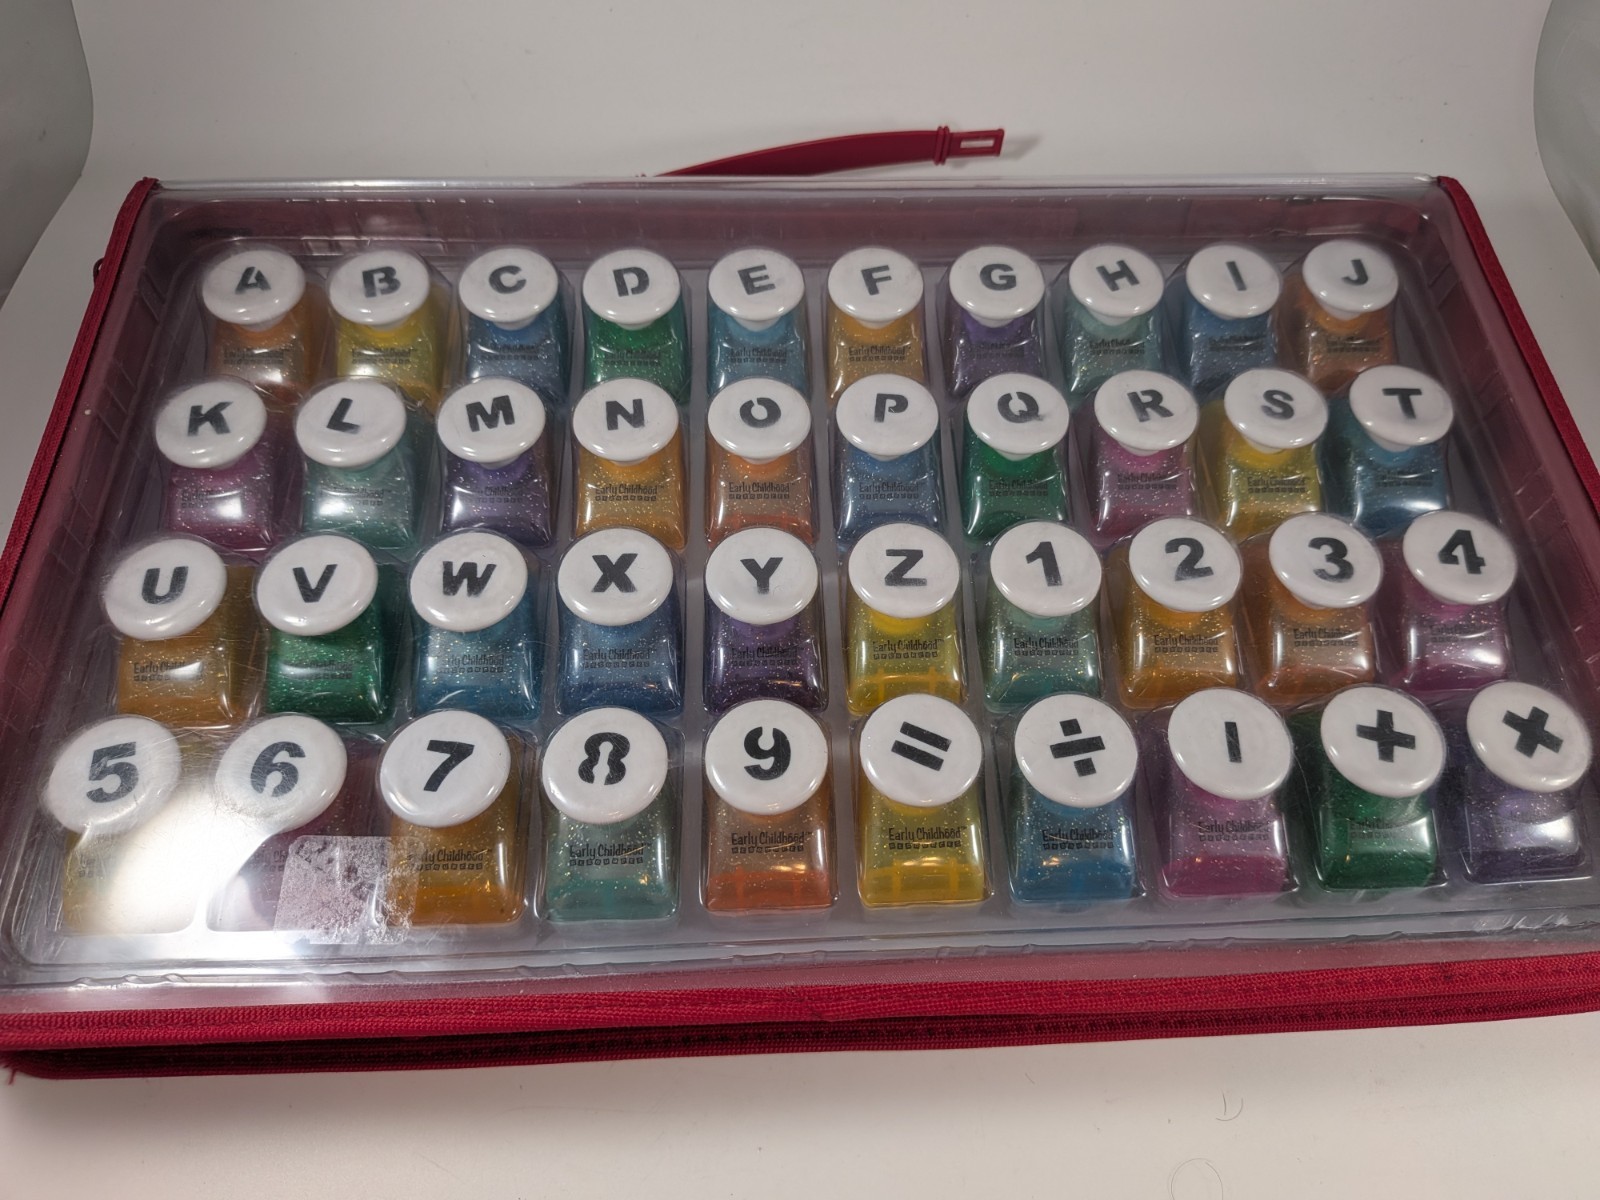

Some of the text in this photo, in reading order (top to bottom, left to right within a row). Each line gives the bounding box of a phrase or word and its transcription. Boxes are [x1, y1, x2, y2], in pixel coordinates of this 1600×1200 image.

[235, 266, 271, 295] A
[361, 265, 401, 298] B
[488, 264, 527, 294] C
[612, 266, 650, 297] D
[737, 264, 776, 296] E
[860, 264, 892, 296] F
[979, 263, 1017, 291] G
[1096, 259, 1140, 292] H
[1229, 260, 1247, 291] I
[1342, 258, 1369, 286] J
[187, 401, 231, 436] K
[326, 397, 360, 434] L
[465, 394, 515, 433] M
[605, 398, 645, 431] N
[739, 397, 782, 429] O
[873, 392, 909, 423] P
[997, 391, 1043, 424] Q
[1127, 389, 1174, 423] R
[1261, 389, 1295, 420] S
[1382, 387, 1423, 420] T
[884, 548, 928, 587] Z
[1025, 541, 1063, 587] 1
[1164, 537, 1214, 582] 2
[1308, 536, 1354, 583] 3
[1438, 529, 1486, 575] 4
[141, 565, 189, 605] U
[292, 563, 338, 604] V
[442, 560, 497, 597] W
[591, 552, 638, 593] X
[739, 556, 784, 595] Y
[250, 741, 306, 795] 6
[423, 739, 475, 793] 7
[577, 731, 631, 786] 8
[743, 726, 792, 781] 9
[87, 741, 138, 803] 5
[731, 832, 757, 847] Early
[889, 827, 915, 842] Early
[570, 844, 596, 860] Early
